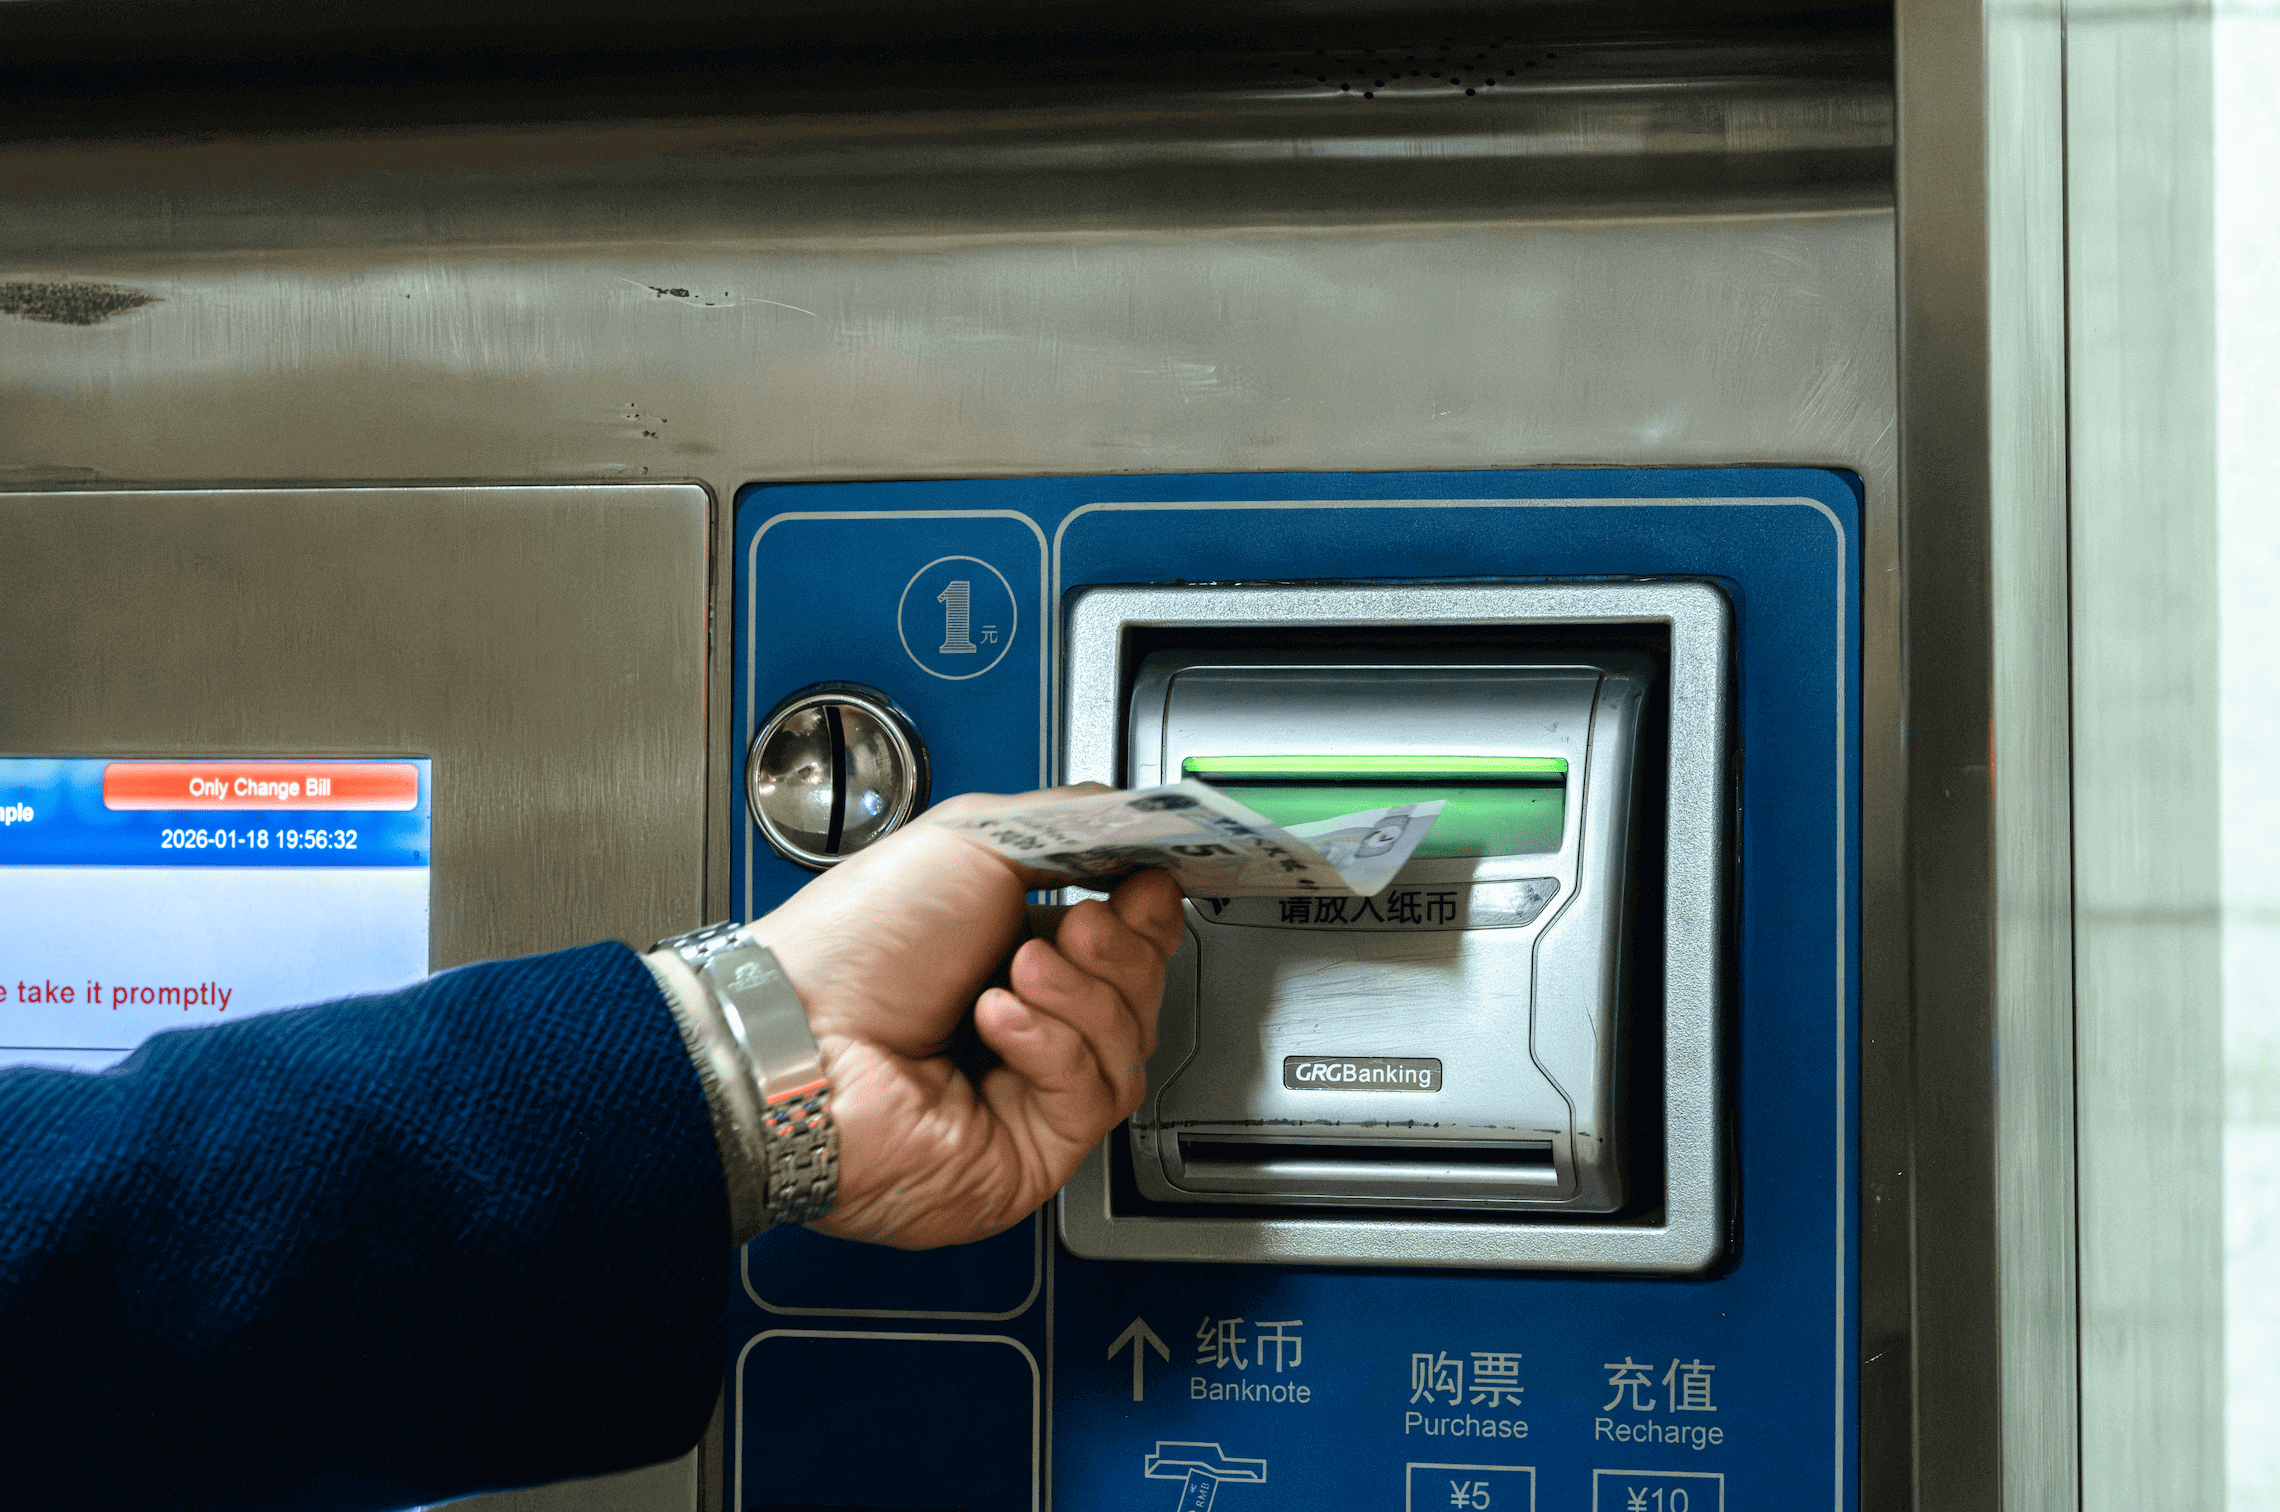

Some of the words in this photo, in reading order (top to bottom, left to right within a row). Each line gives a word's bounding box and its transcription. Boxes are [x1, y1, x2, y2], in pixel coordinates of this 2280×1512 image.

[189, 778, 229, 800] Only
[234, 777, 300, 800] Change
[305, 777, 331, 796] Bill
[161, 829, 269, 849] 2026-01-18
[276, 829, 358, 849] 19:56:32
[1279, 890, 1457, 925] 请放入纸币
[18, 980, 75, 1003] take
[87, 980, 102, 1004] it
[113, 981, 232, 1012] promptly
[1296, 1062, 1432, 1088] GRGBanking
[1195, 1316, 1304, 1374] 纸币
[1190, 1377, 1311, 1404] Banknote
[1408, 1351, 1524, 1408] 购票
[1602, 1357, 1718, 1412] 充值
[1405, 1412, 1528, 1439] Purchase
[1594, 1417, 1724, 1450] Recharge
[1450, 1480, 1490, 1510] ¥5
[1627, 1486, 1689, 1512] ¥10
